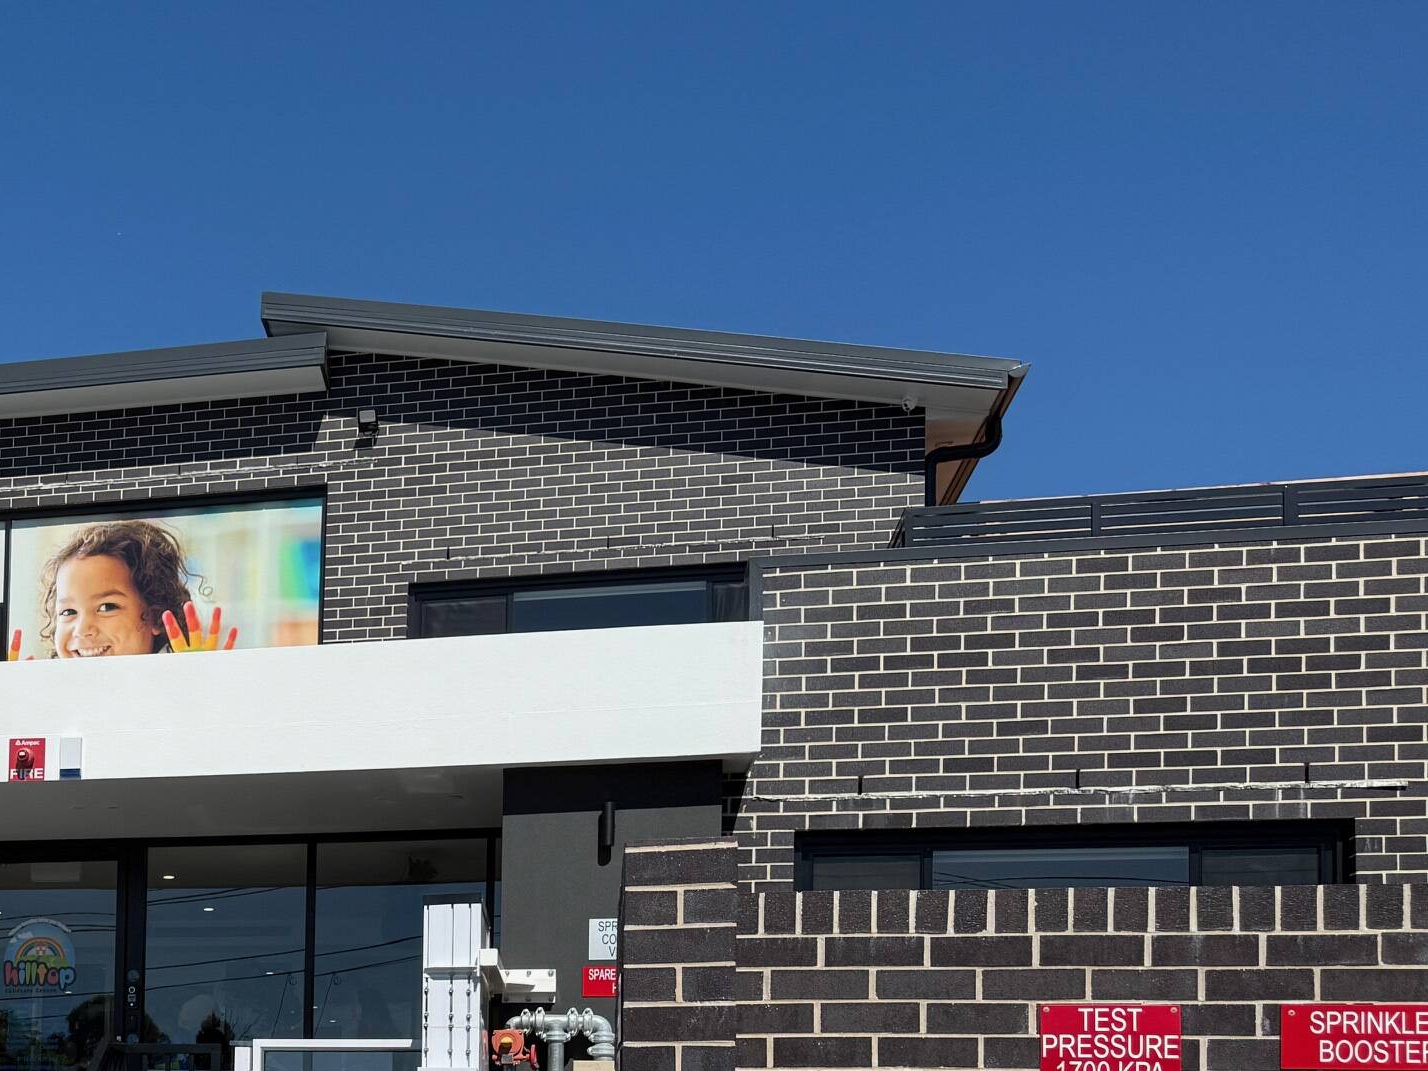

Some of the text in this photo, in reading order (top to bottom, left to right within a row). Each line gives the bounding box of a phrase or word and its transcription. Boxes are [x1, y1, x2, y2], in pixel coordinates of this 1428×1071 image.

[4, 960, 76, 990] hilltop
[588, 968, 617, 981] SPARE
[1078, 1007, 1143, 1032] TEST
[1309, 1010, 1428, 1035] SPRINKLE
[1042, 1034, 1180, 1060] PRESSURE
